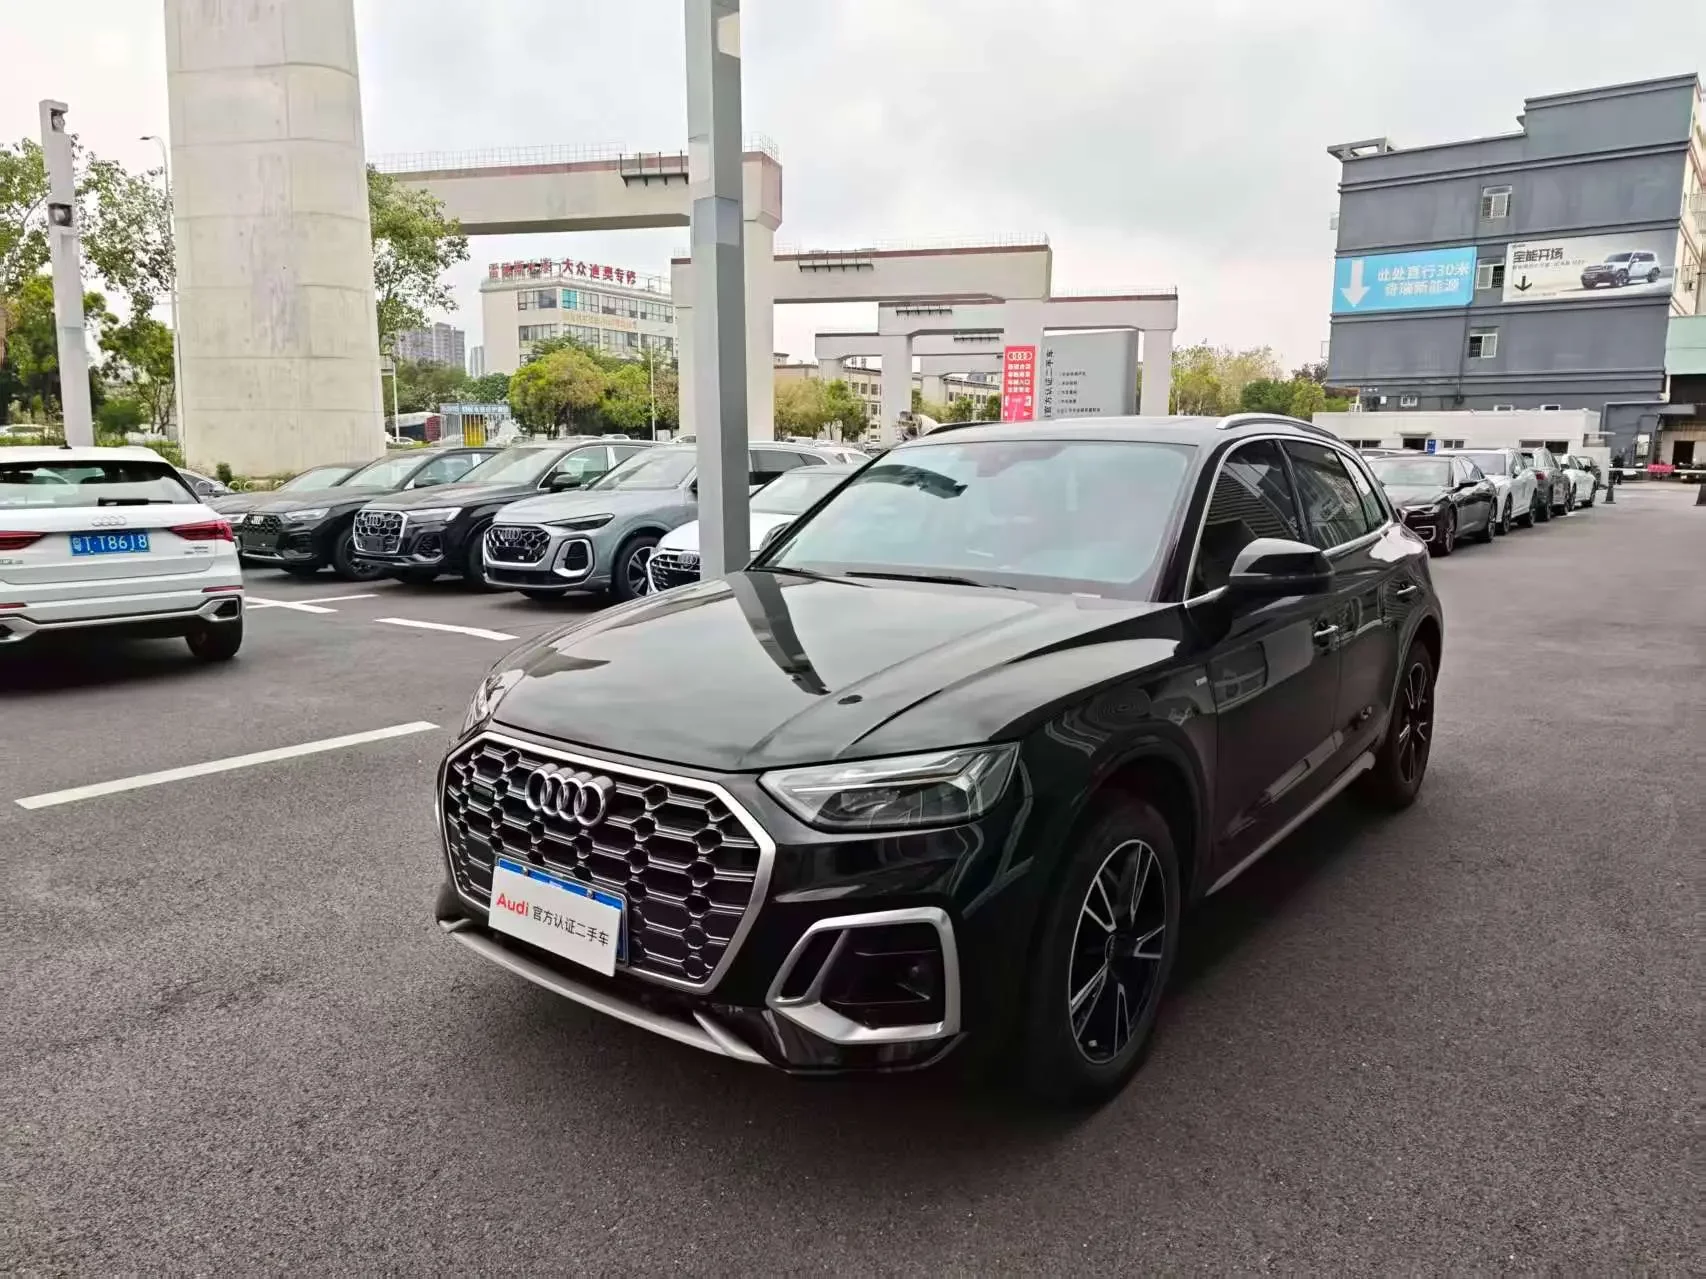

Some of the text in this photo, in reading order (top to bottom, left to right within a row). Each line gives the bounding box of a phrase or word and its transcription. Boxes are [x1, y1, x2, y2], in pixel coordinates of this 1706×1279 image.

[496, 893, 610, 947] Audi 官方认证二手车
